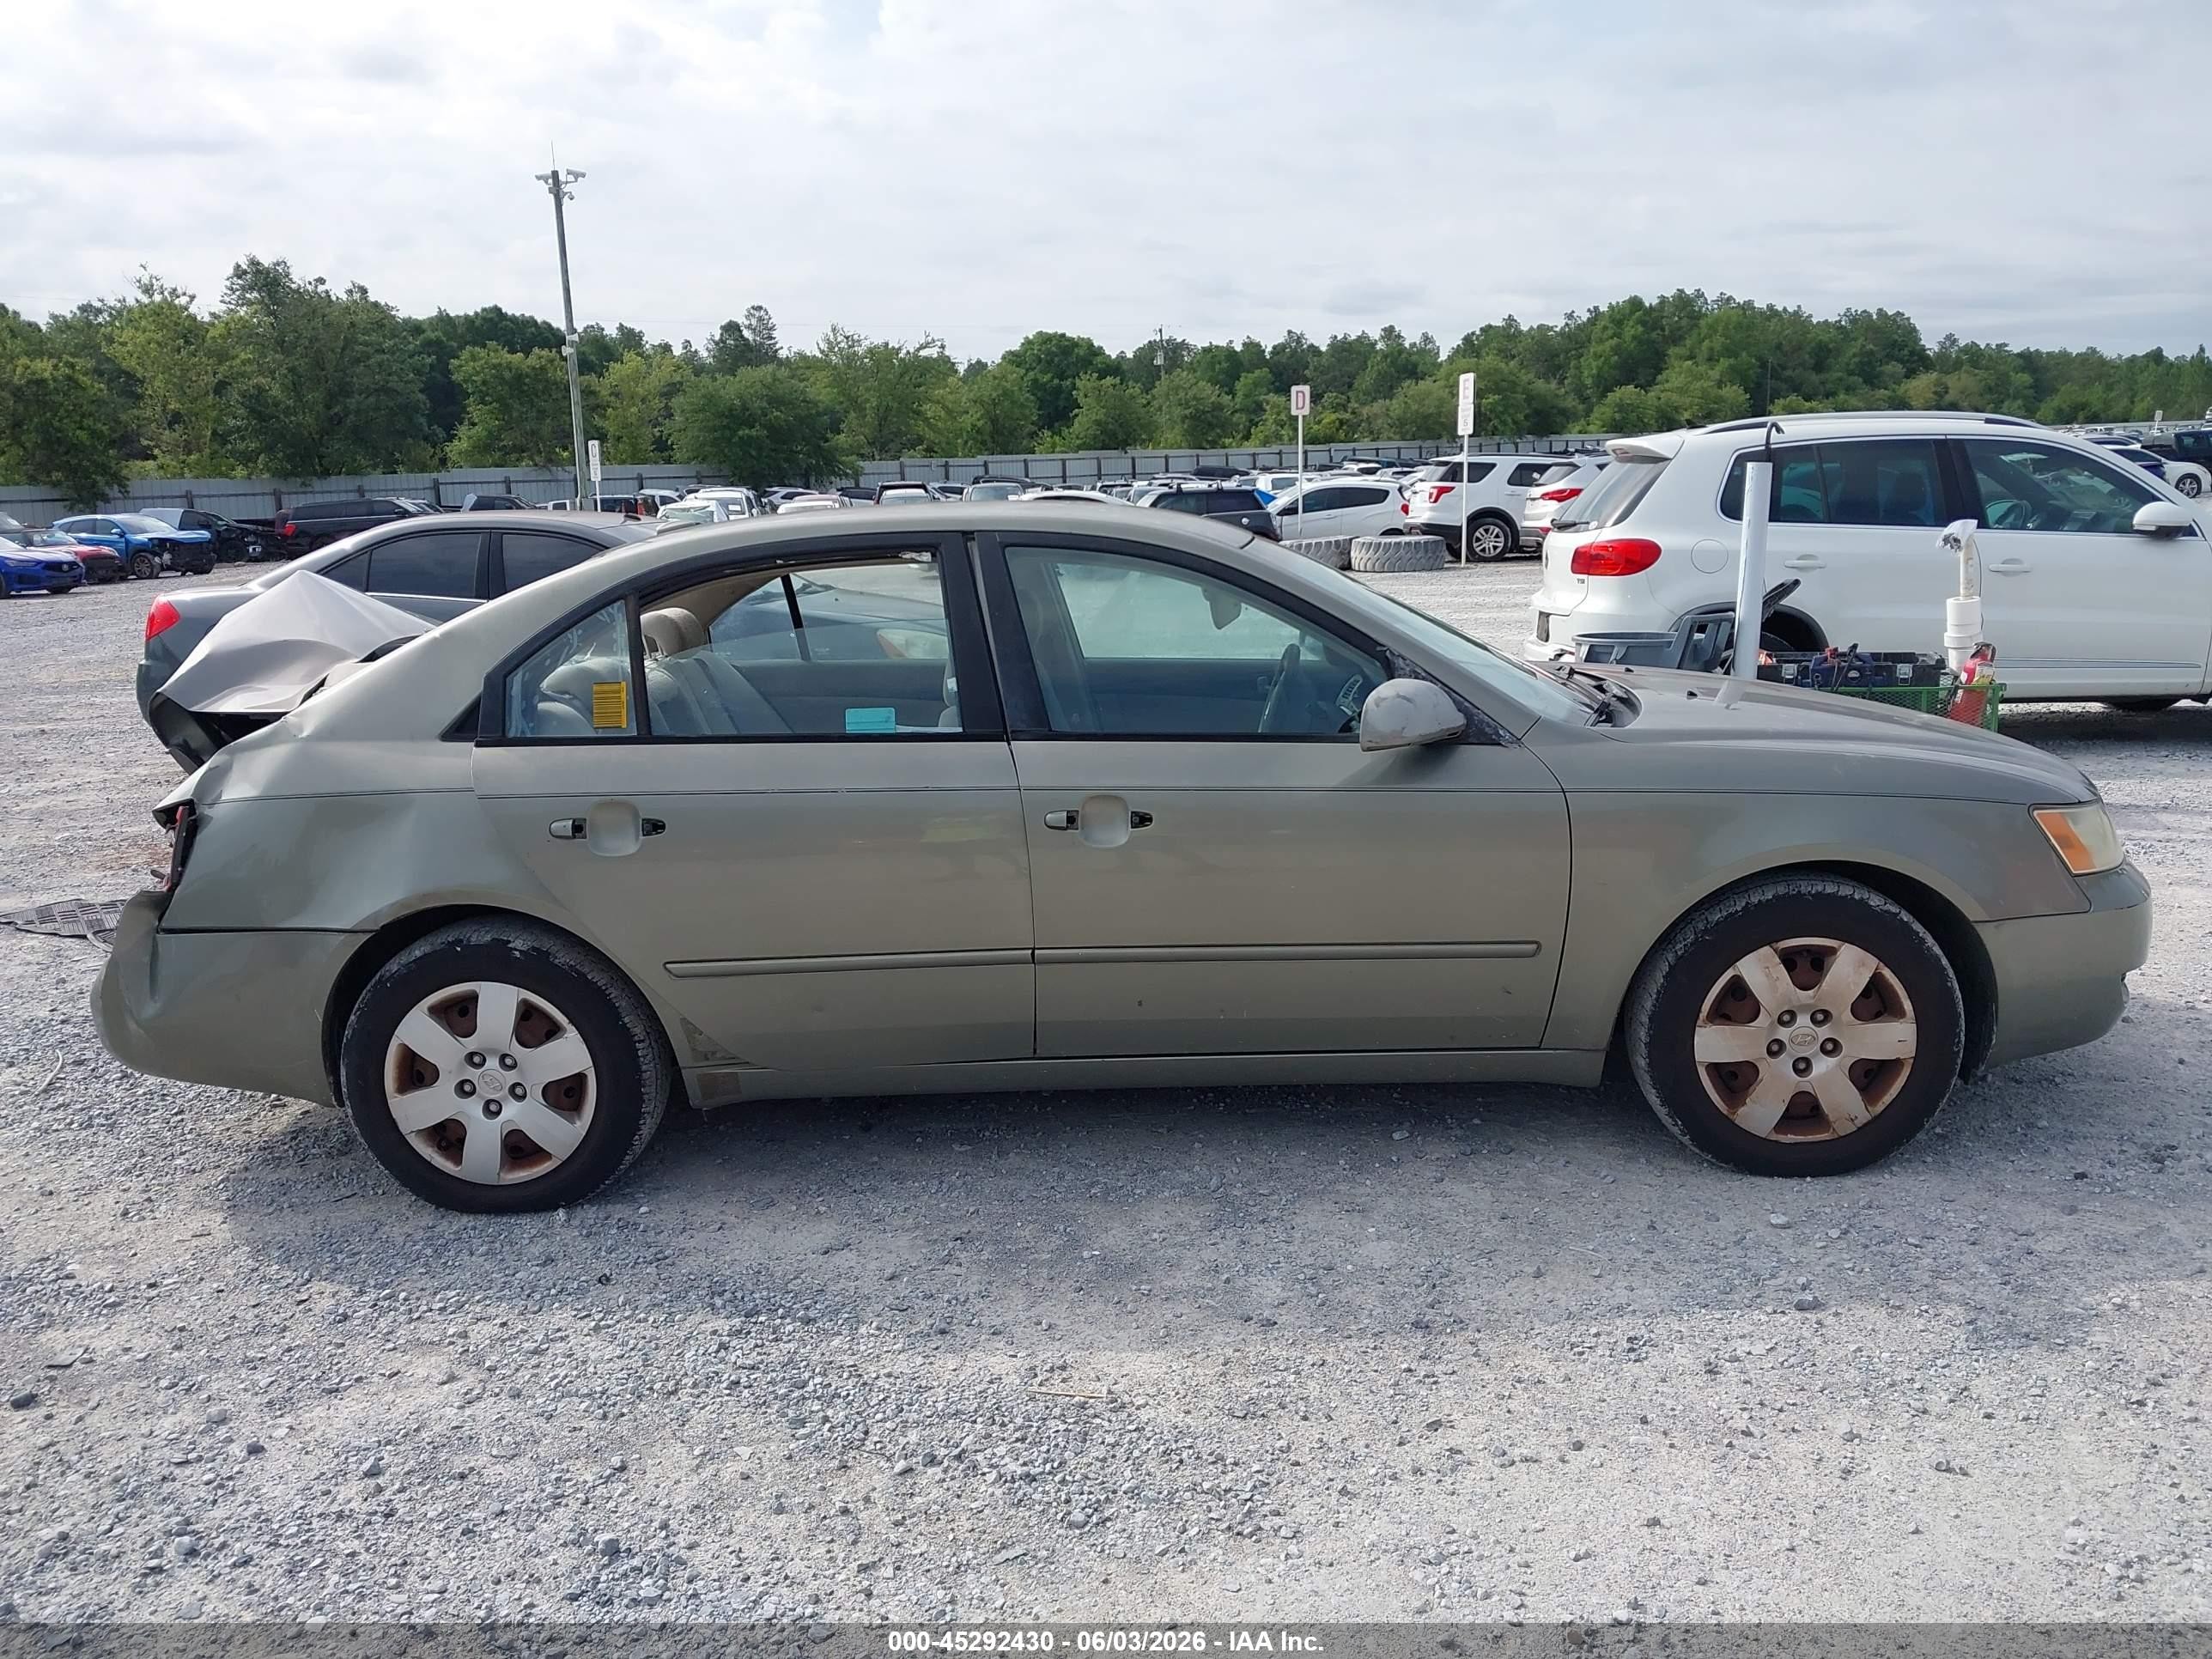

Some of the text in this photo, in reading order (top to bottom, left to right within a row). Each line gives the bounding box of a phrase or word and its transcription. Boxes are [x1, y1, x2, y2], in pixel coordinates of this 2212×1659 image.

[1462, 378, 1470, 400] E
[1296, 390, 1306, 410] D
[591, 443, 597, 458] C
